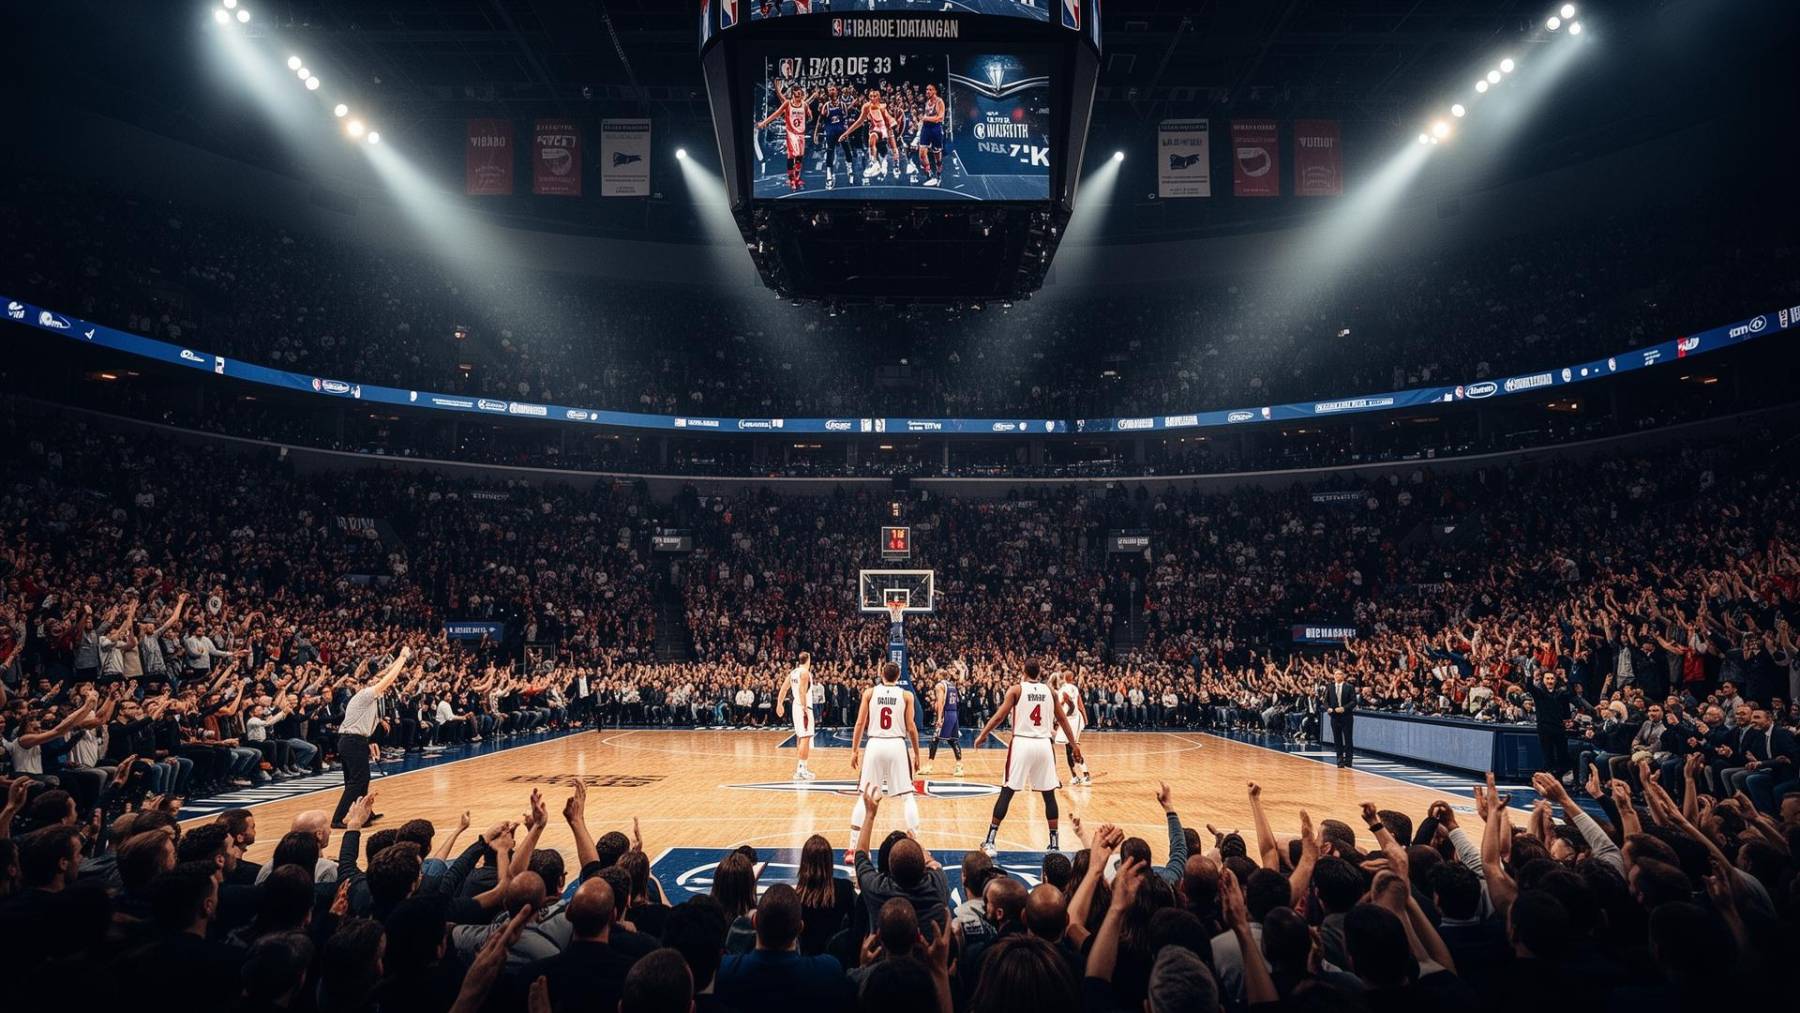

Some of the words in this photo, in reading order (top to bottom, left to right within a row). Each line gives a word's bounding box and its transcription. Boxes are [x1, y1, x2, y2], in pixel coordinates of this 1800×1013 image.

[873, 57, 892, 74] 33
[880, 706, 892, 730] 6
[1029, 704, 1042, 727] 4
